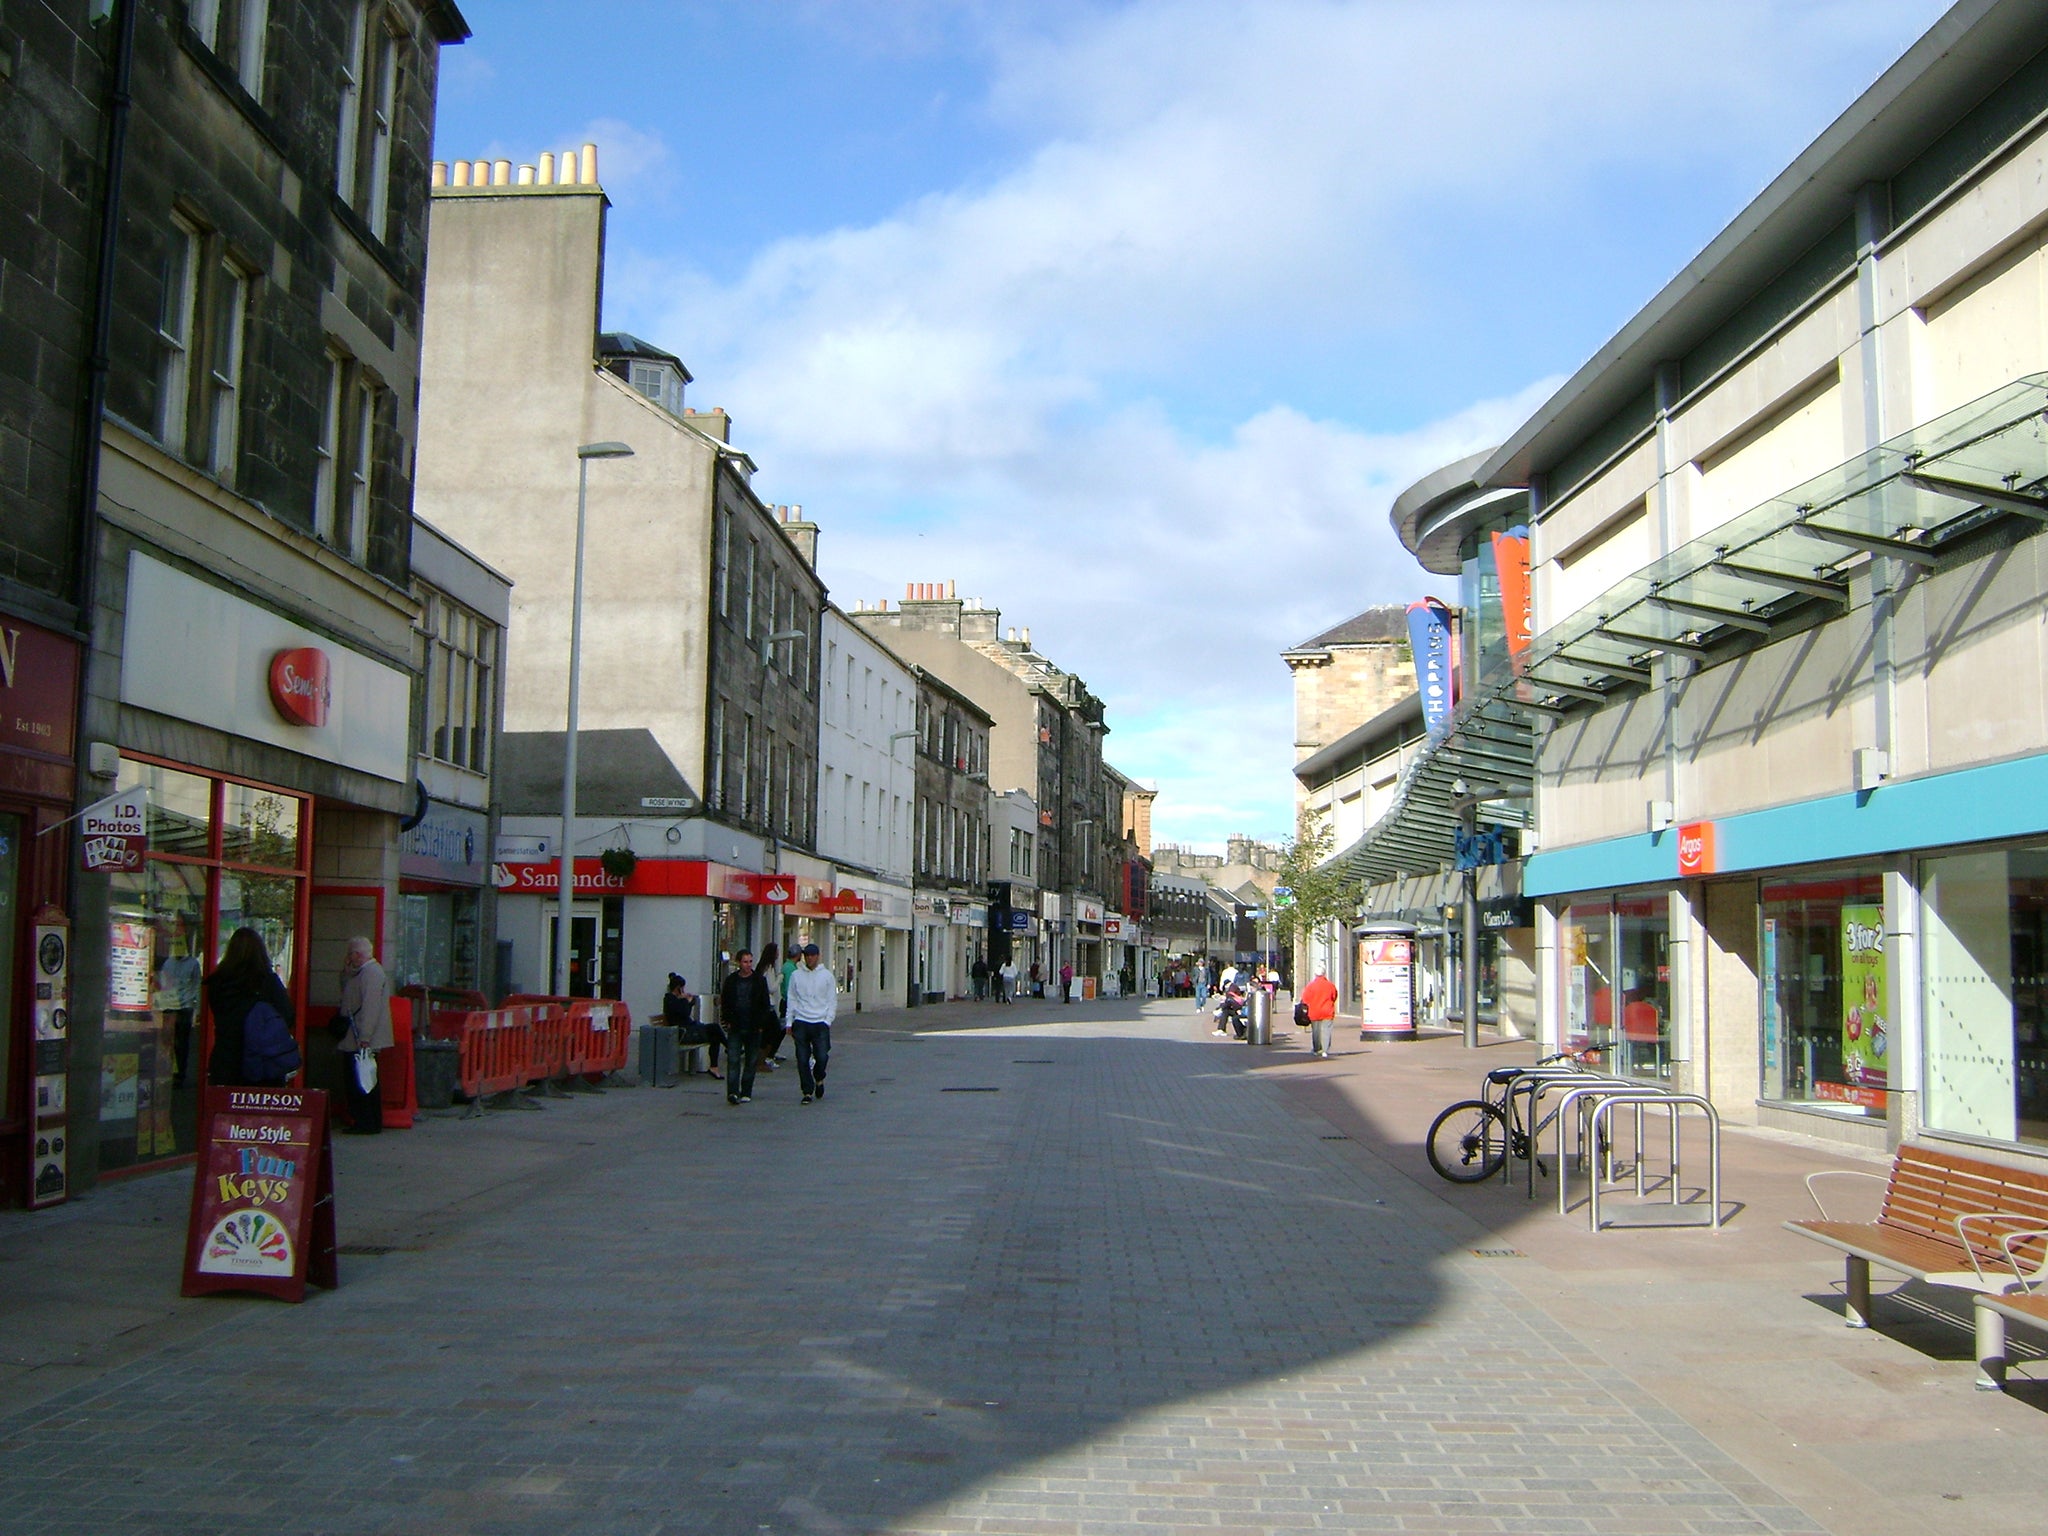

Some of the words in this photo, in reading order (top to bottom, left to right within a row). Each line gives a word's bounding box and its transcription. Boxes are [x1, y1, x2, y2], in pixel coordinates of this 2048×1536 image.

[1428, 623, 1443, 724] SHOPPING
[115, 804, 141, 818] I.D.
[648, 799, 665, 807] ROSE
[87, 818, 141, 833] Photos
[1680, 836, 1701, 858] Argos
[521, 866, 625, 888] Sanander
[914, 901, 929, 911] bon
[1846, 921, 1856, 951] 3
[1857, 923, 1876, 951] for
[1873, 922, 1884, 953] 2
[230, 1092, 303, 1106] TIMPSON
[230, 1125, 258, 1139] New
[260, 1126, 292, 1144] Style
[237, 1147, 296, 1179] Fun
[217, 1172, 289, 1206] Keys
